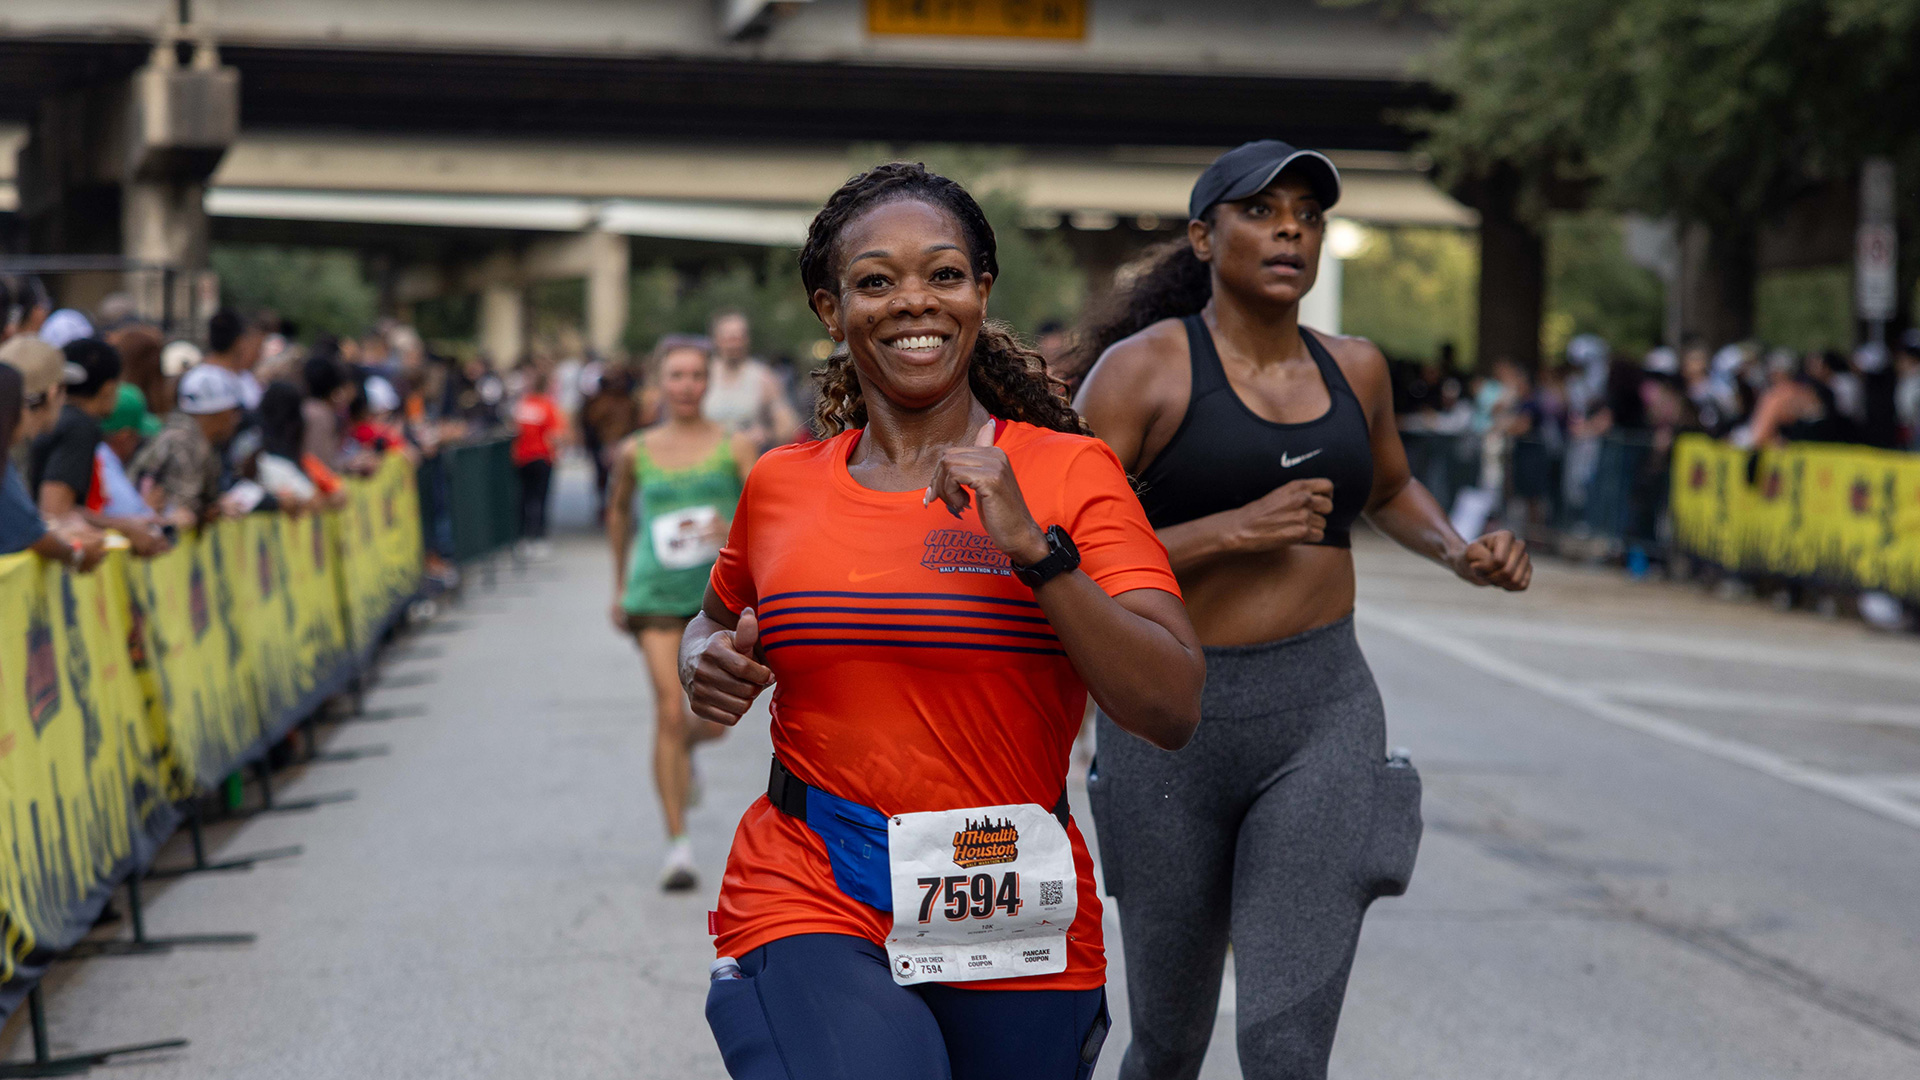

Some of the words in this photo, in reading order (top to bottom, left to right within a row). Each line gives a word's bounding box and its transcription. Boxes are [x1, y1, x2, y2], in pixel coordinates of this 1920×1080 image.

[924, 529, 997, 549] UTHea
[923, 545, 1011, 569] Houston
[958, 566, 991, 574] MARATHON
[953, 828, 1017, 846] UTHealth
[953, 843, 1015, 860] Houston
[917, 871, 1023, 924] 7594
[1023, 949, 1050, 957] PANCAKE
[920, 965, 943, 974] 7594
[967, 960, 993, 968] COUPON
